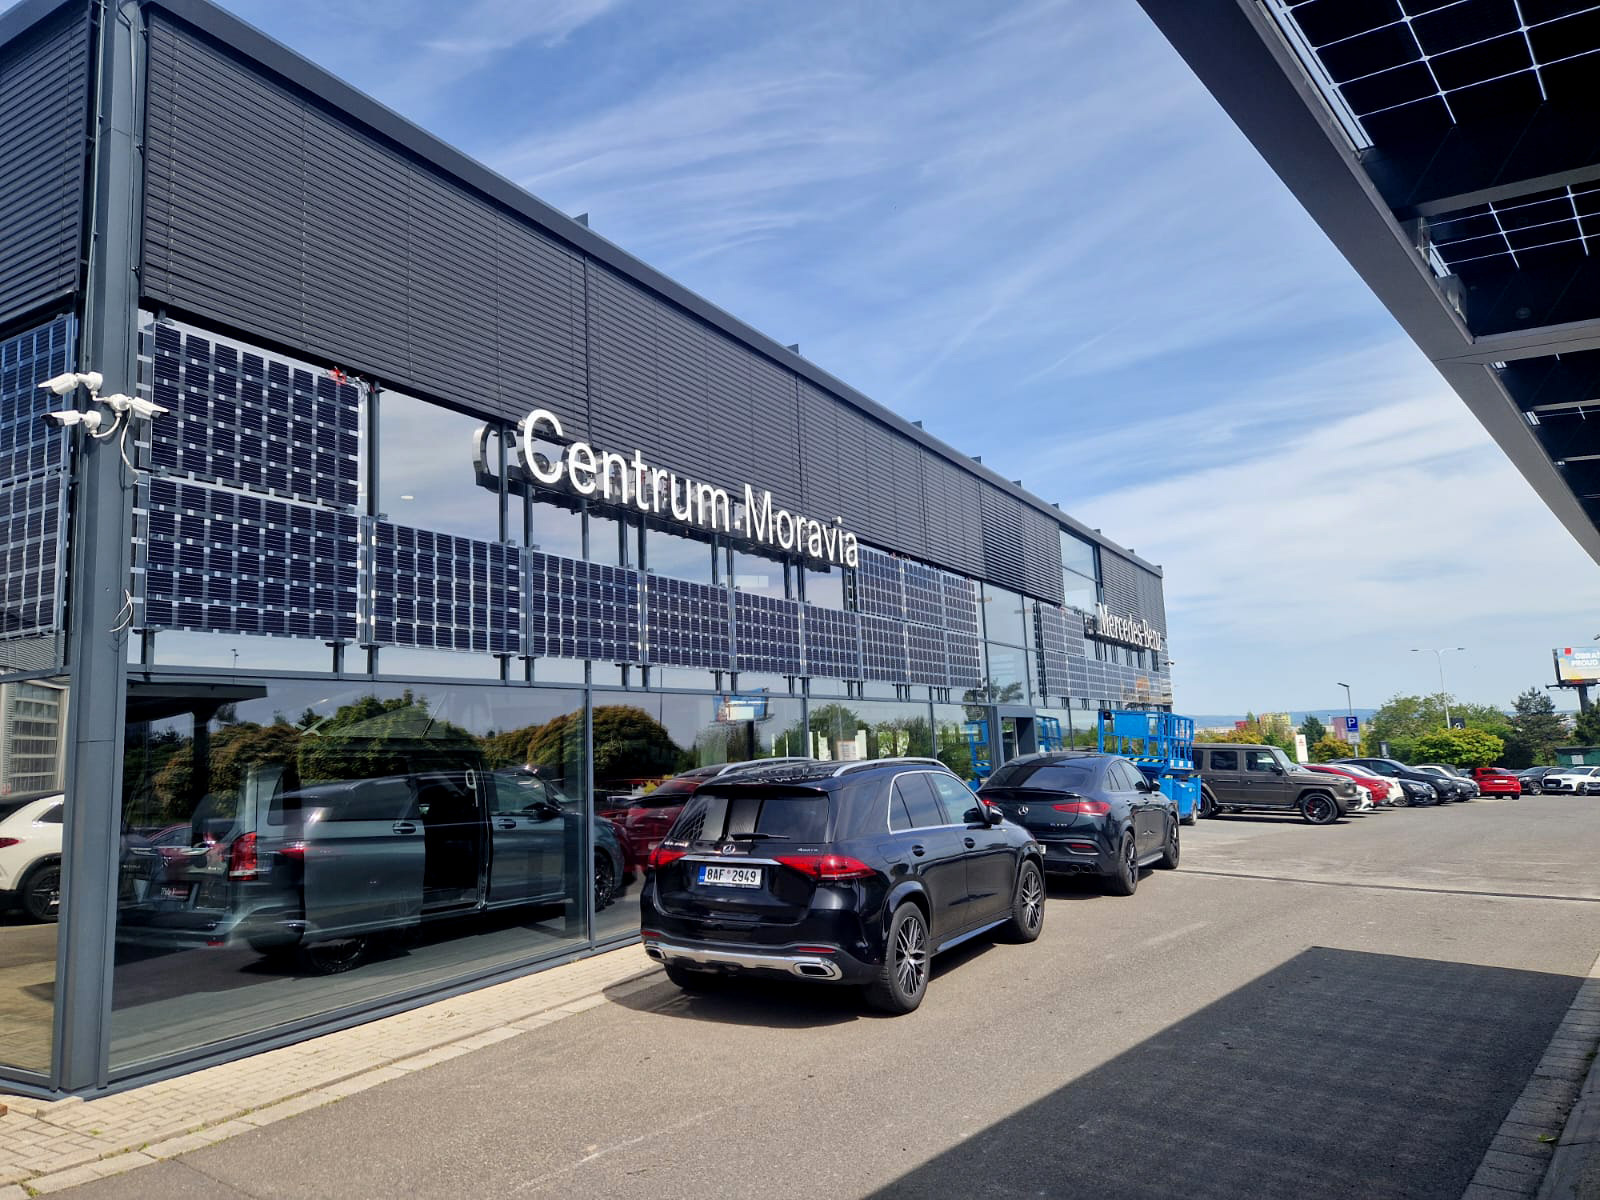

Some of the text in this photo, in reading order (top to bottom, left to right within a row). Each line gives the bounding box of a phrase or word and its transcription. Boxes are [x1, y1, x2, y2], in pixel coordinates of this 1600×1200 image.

[523, 408, 859, 568] Centrum Moravia
[1347, 717, 1356, 728] P
[707, 868, 757, 883] 8AF 2949
